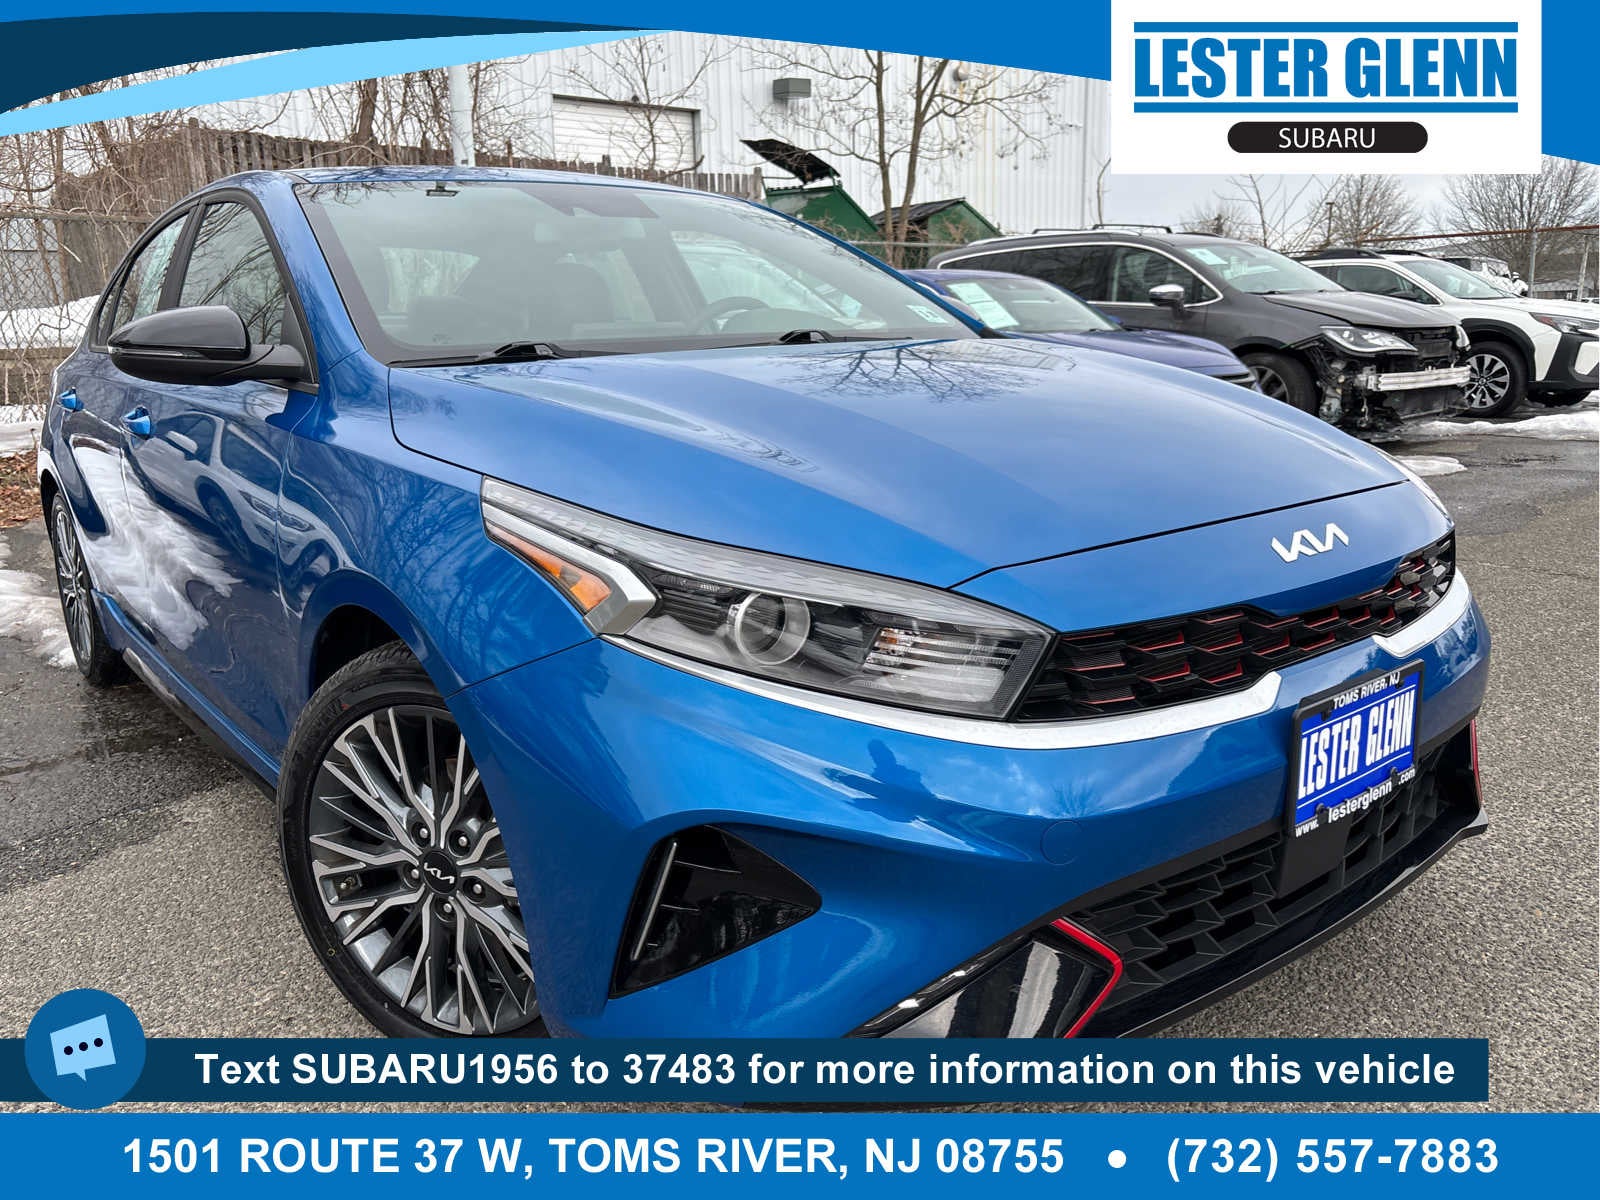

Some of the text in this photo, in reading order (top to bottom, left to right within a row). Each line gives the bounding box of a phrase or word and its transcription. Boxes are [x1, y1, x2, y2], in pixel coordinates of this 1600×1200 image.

[1333, 692, 1360, 710] TOMS
[1389, 671, 1401, 688] NJ
[1297, 689, 1416, 800] LESTER GLENN
